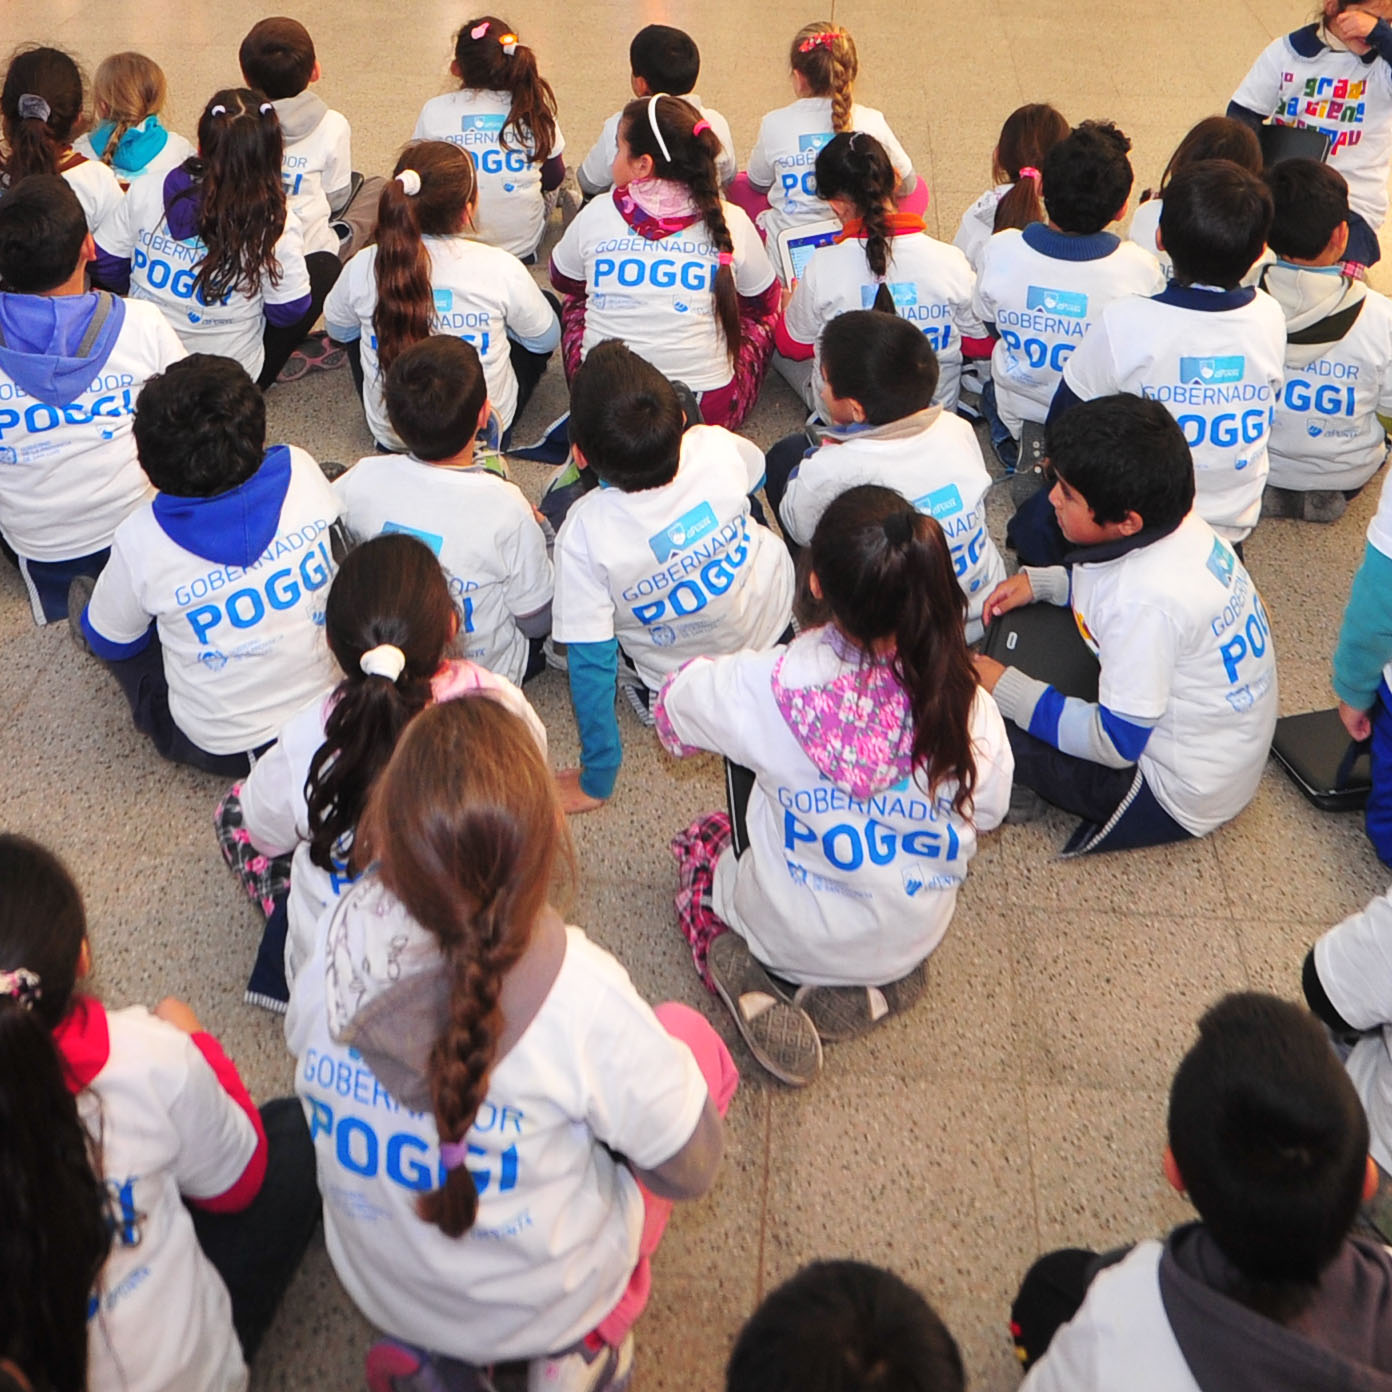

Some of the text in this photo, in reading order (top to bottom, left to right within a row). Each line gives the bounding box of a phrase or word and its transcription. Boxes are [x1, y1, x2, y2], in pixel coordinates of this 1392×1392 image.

[1001, 329, 1077, 373] POG
[1142, 383, 1270, 406] GOBERNADO
[186, 540, 334, 645] POGGI
[783, 808, 960, 872] POGGI
